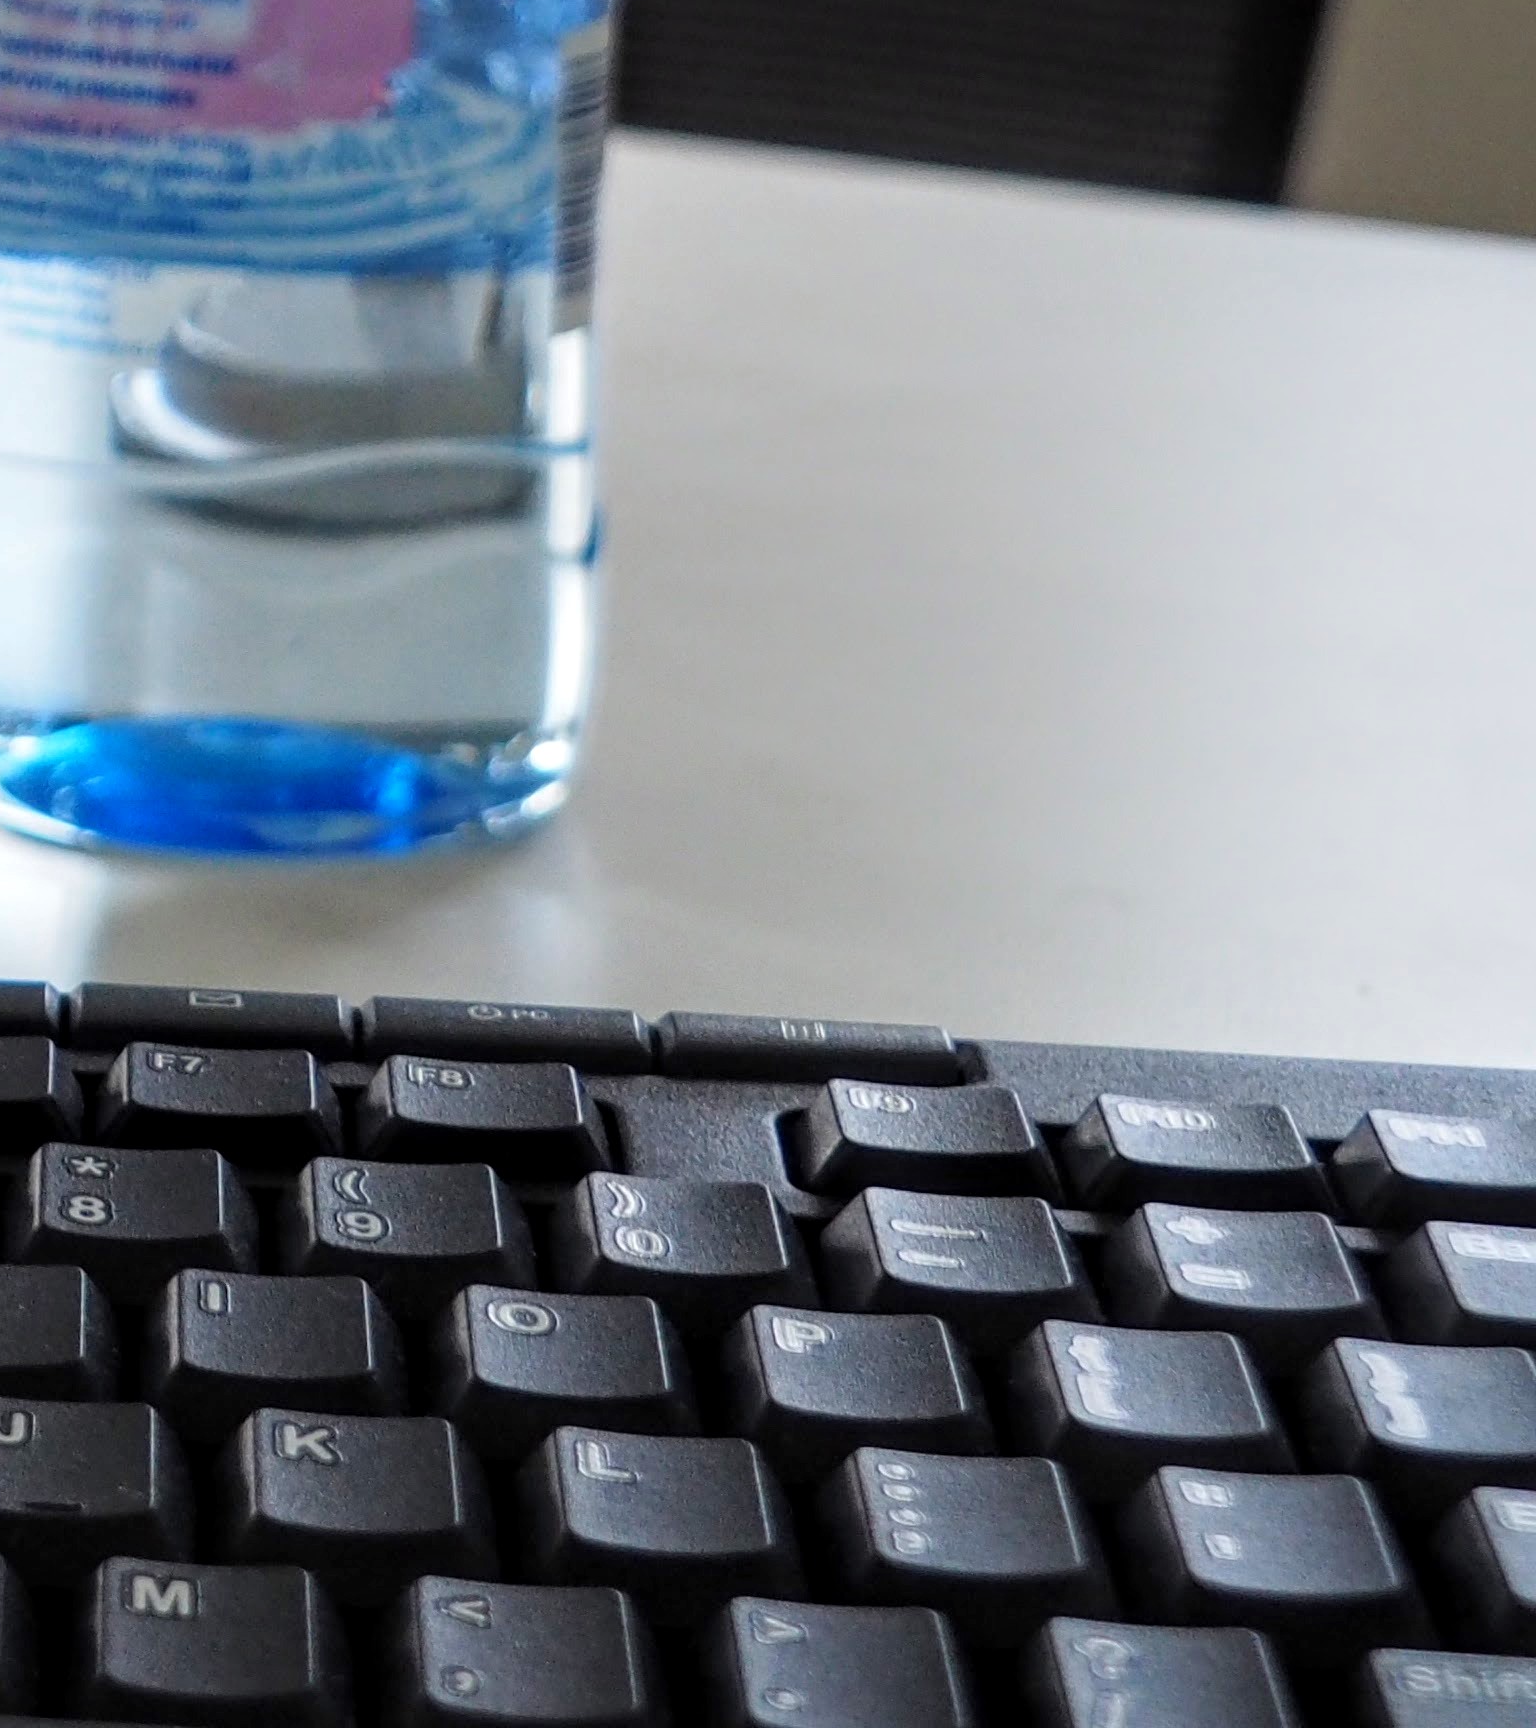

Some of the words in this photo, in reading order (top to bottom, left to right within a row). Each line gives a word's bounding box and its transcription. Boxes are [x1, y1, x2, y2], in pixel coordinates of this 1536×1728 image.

[154, 1053, 203, 1072] F7
[412, 1067, 465, 1087] F8
[69, 1197, 108, 1224] 8
[341, 1212, 385, 1240] 9
[206, 1281, 223, 1311] I
[489, 1302, 554, 1333] O
[773, 1317, 828, 1352] P
[281, 1425, 334, 1461] K
[578, 1441, 637, 1481] L
[133, 1577, 192, 1617] M
